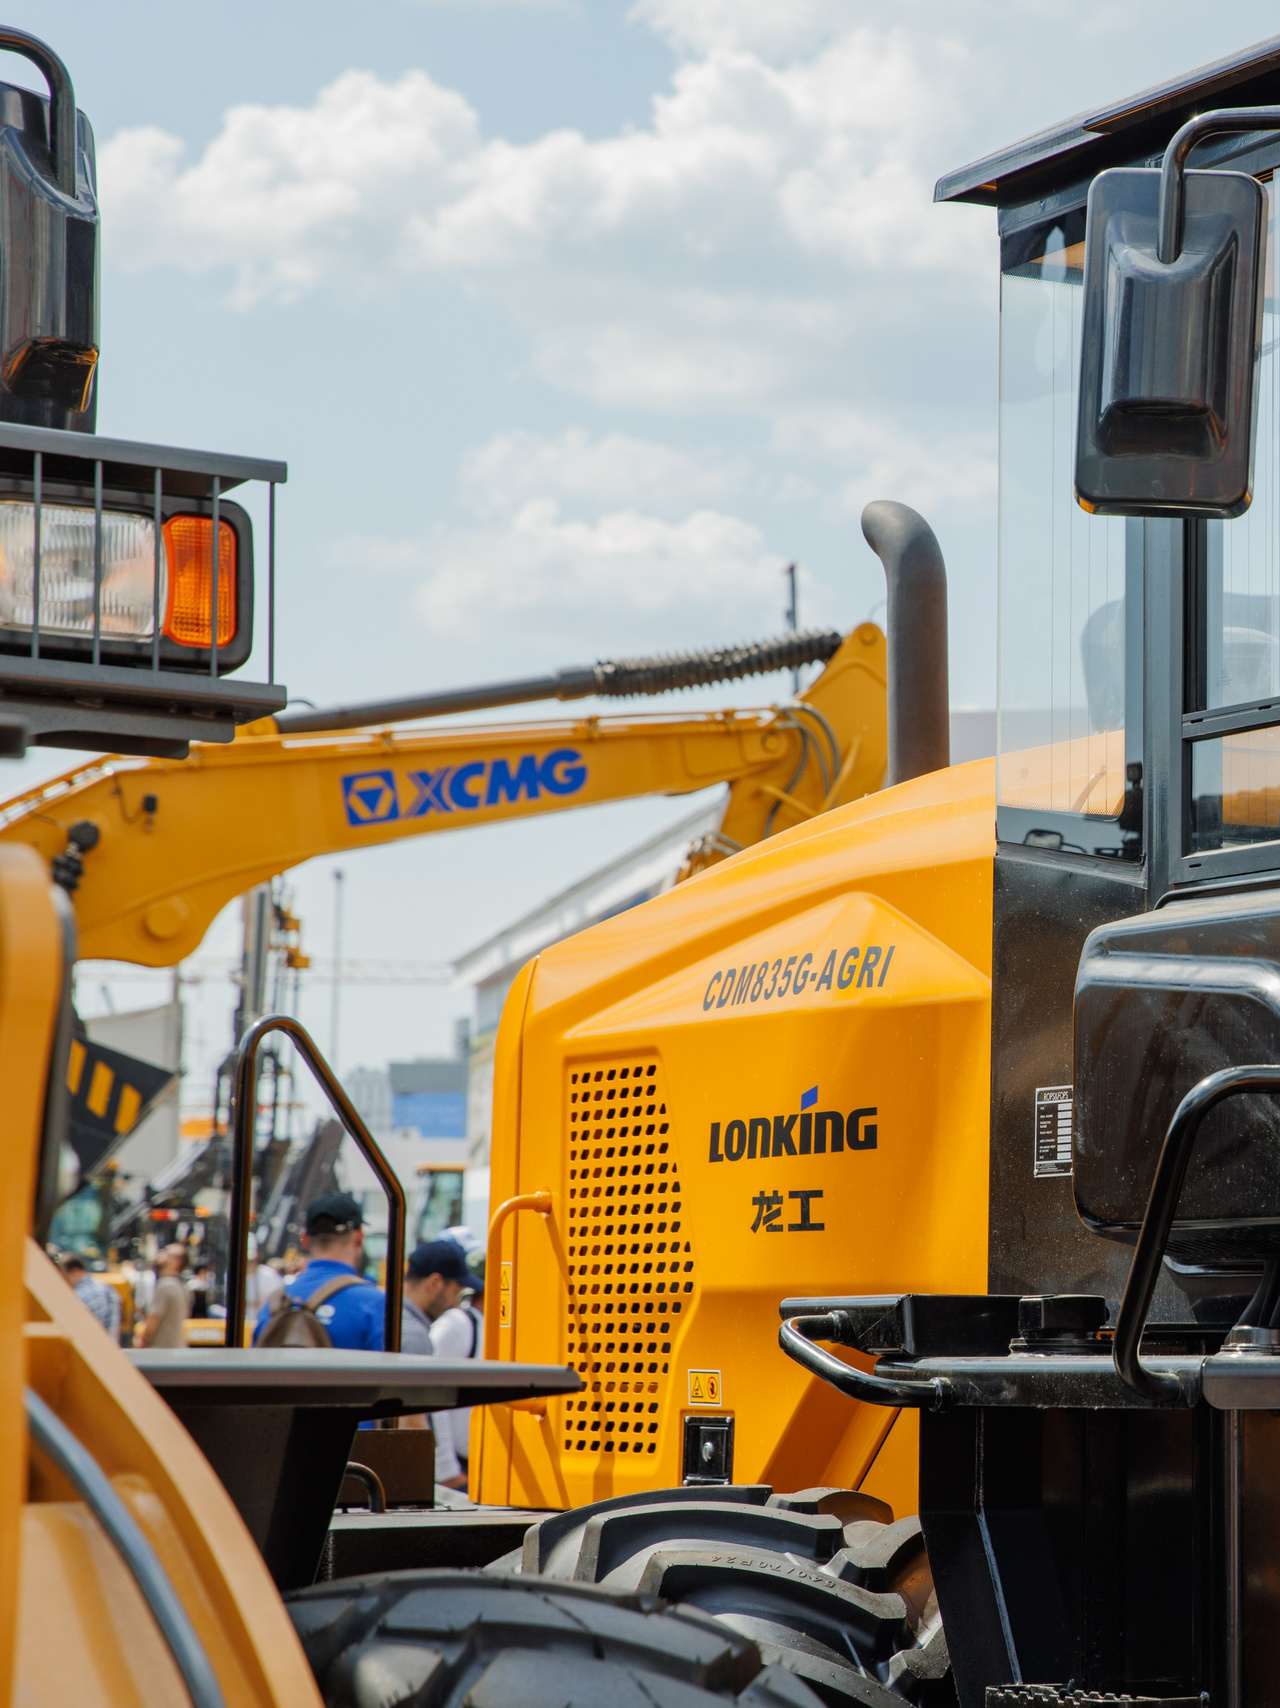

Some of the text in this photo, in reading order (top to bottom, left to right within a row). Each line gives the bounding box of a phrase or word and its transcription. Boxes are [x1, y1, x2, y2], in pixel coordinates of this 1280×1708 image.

[402, 748, 588, 819] XCMG
[702, 945, 896, 1012] CDM835G-AGRI
[708, 1085, 878, 1163] LONKING
[750, 1189, 825, 1234] 龙工
